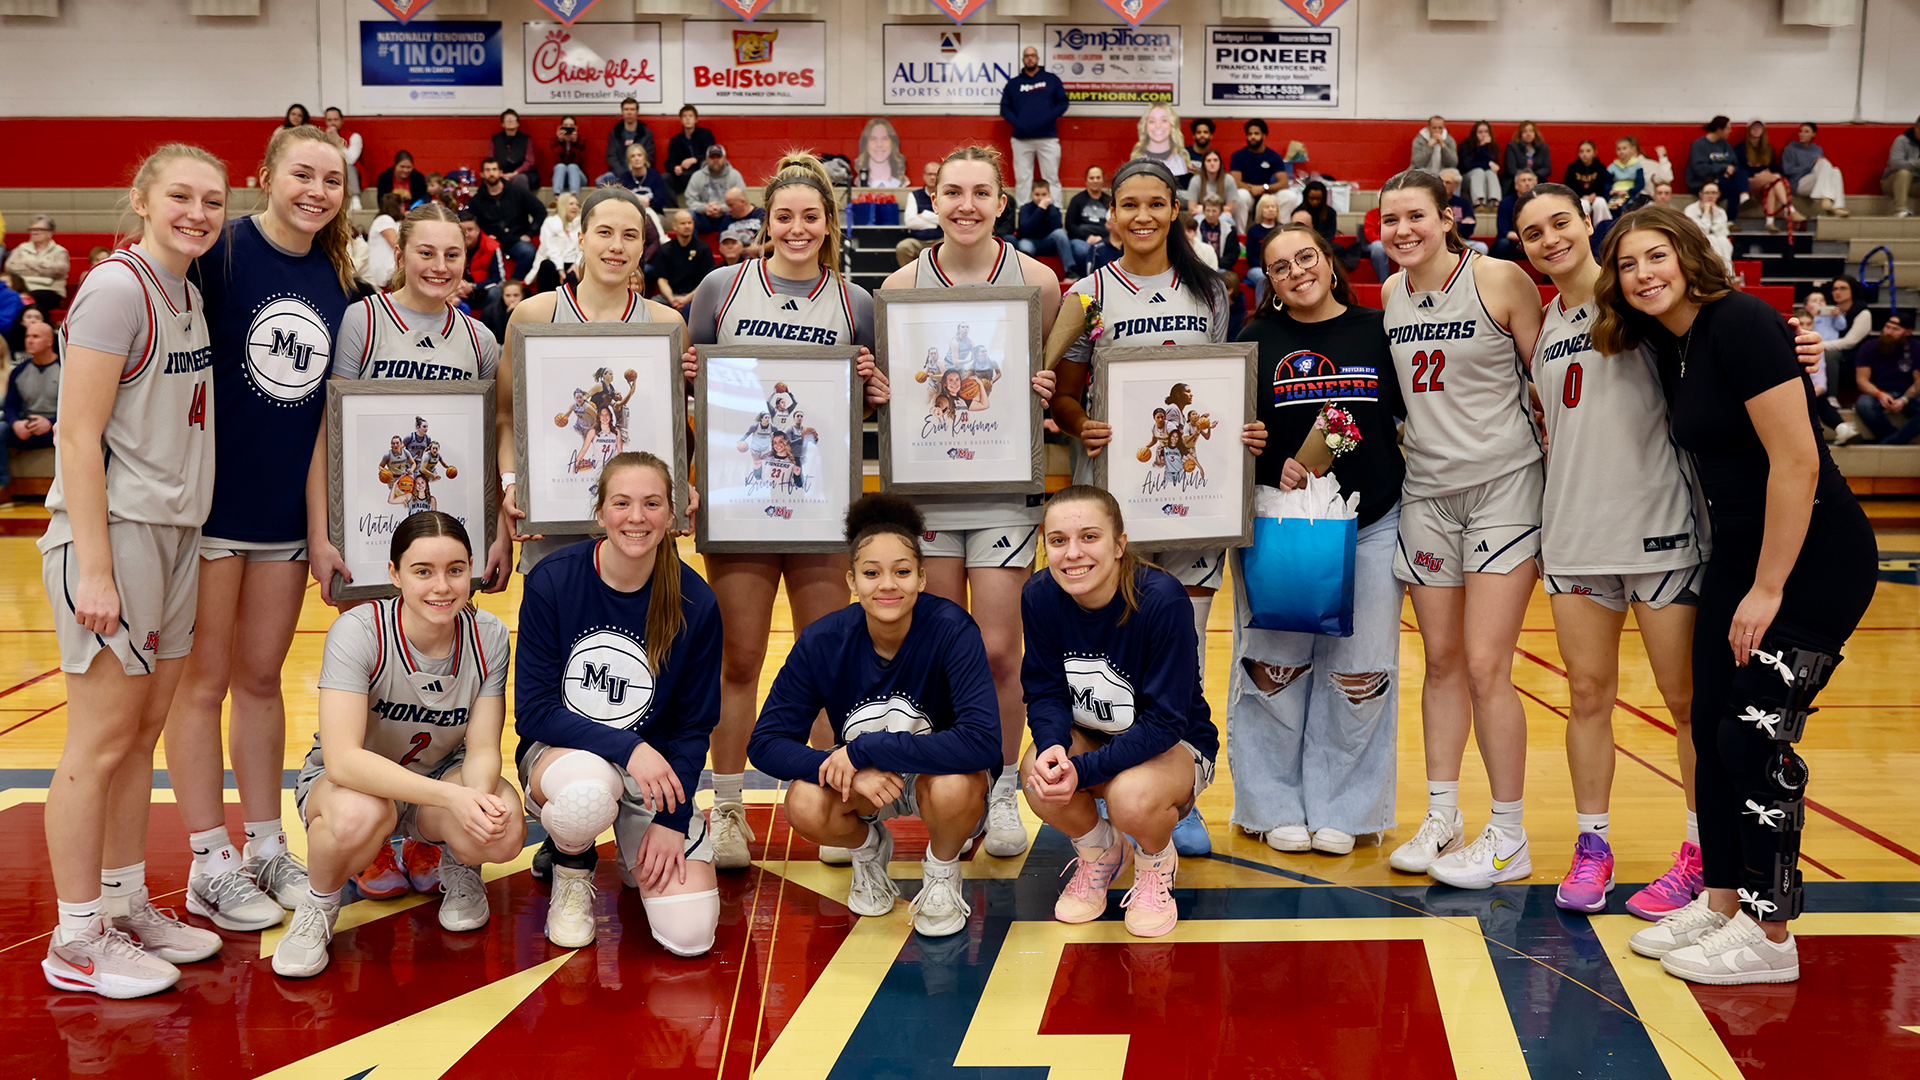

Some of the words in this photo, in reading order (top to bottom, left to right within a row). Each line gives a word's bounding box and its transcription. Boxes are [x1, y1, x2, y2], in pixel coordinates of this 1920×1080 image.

[377, 32, 431, 42] NATIONALLY
[433, 32, 485, 42] RENOWNED
[378, 44, 400, 65] #1
[404, 44, 426, 65] IN
[430, 44, 485, 65] OHIO
[532, 39, 655, 88] Chick-fil-A
[1216, 48, 1326, 63] PIONEER
[892, 62, 1011, 83] AULTMAN
[550, 91, 571, 99] 5411
[574, 91, 610, 99] Dressler
[613, 91, 637, 99] Road
[892, 88, 940, 97] SPORTS
[946, 88, 1004, 97] MEDICIN
[734, 319, 838, 345] PIONEERS
[1113, 315, 1208, 340] PIONEERS
[1388, 320, 1476, 346] PIONEERS
[269, 327, 315, 373] MU
[371, 360, 472, 380] PIONEERS
[1412, 349, 1445, 393] 22
[1274, 380, 1378, 402] PIONEERS
[1562, 362, 1583, 409] 0
[921, 414, 948, 439] Erin
[951, 414, 999, 438] Kaufman
[602, 444, 611, 453] 24
[956, 448, 976, 460] MU
[771, 468, 782, 478] 23
[774, 506, 793, 519] MU
[1172, 504, 1189, 516] MU
[1413, 550, 1444, 573] MU
[580, 661, 630, 706] MU
[1069, 683, 1115, 723] MU
[399, 731, 432, 766] 2
